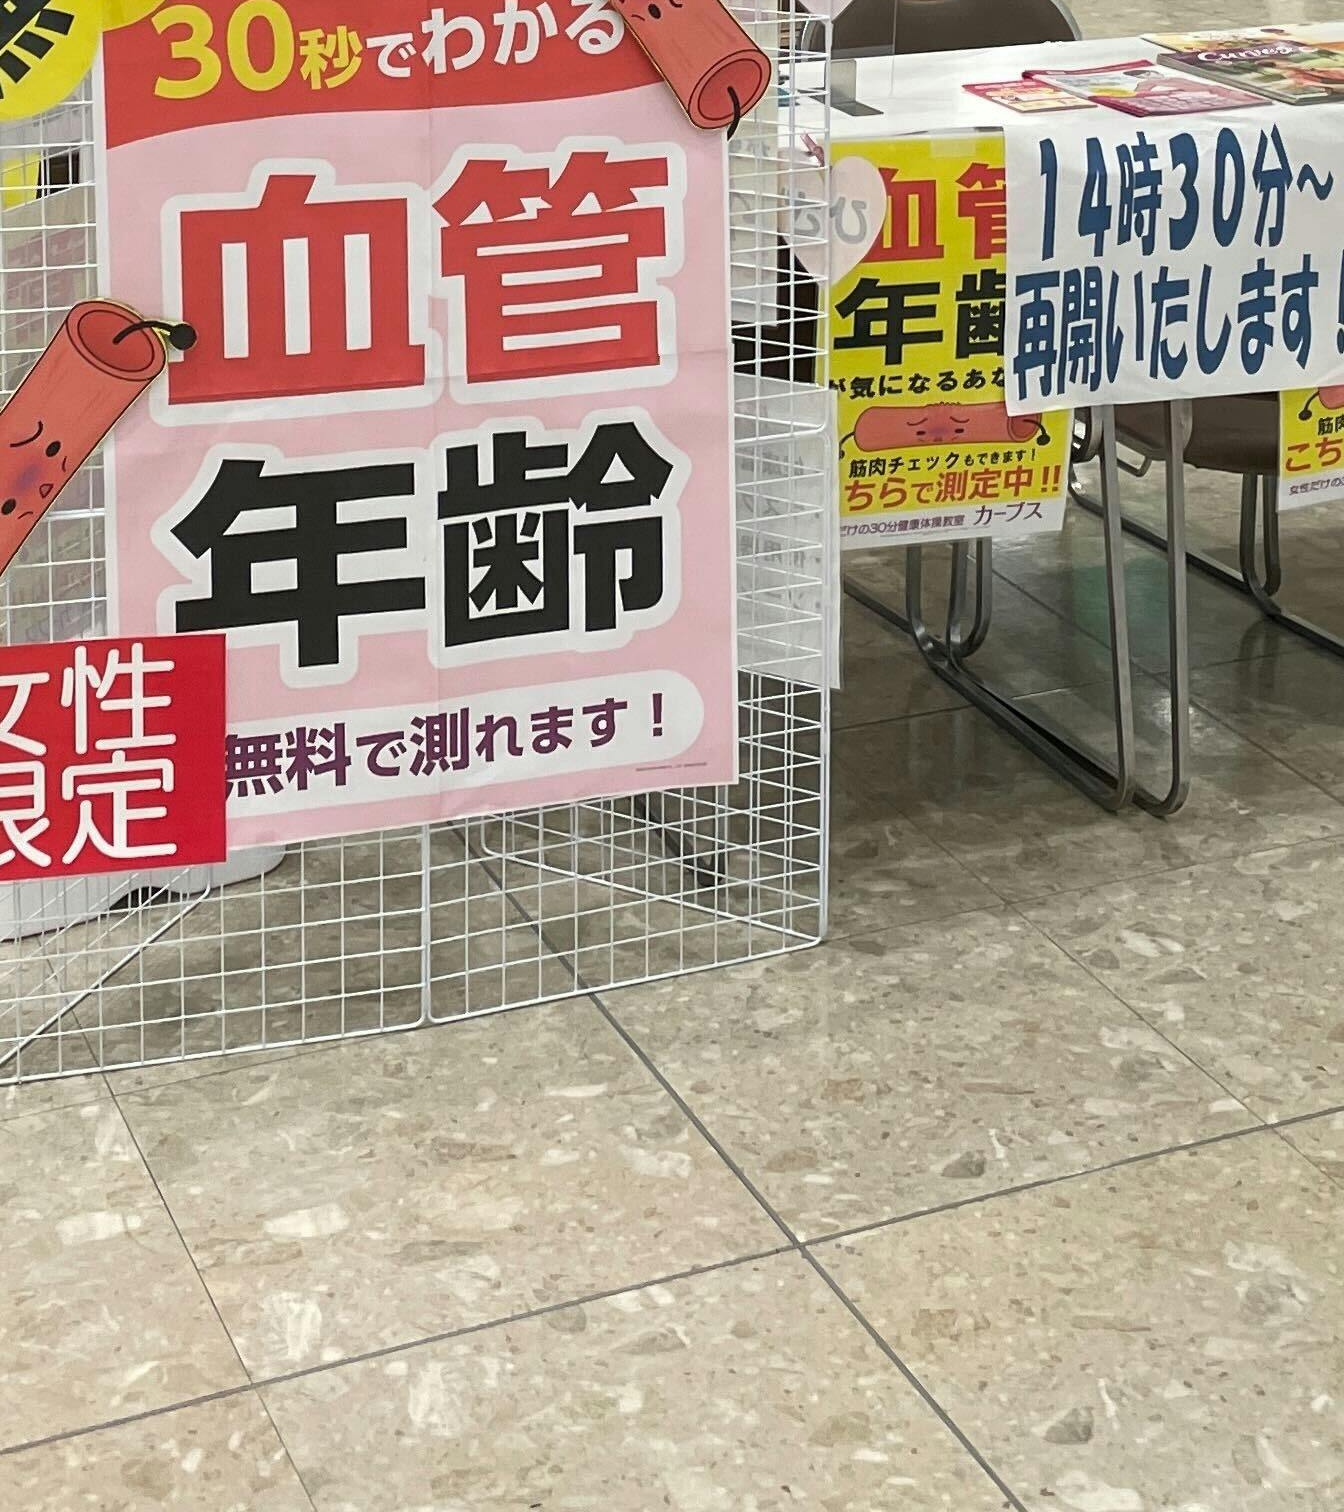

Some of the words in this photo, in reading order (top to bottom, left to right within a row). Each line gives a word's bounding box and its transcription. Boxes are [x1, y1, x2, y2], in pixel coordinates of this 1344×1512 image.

[1197, 44, 1294, 63] Curves
[1038, 125, 1334, 261] 14時30分～
[167, 150, 669, 406] 血管
[849, 448, 1036, 478] 筋肉チェックもできます！
[973, 501, 1043, 526] カーブス
[171, 421, 674, 667] 年齢
[224, 694, 668, 798] 無料で測れます！
